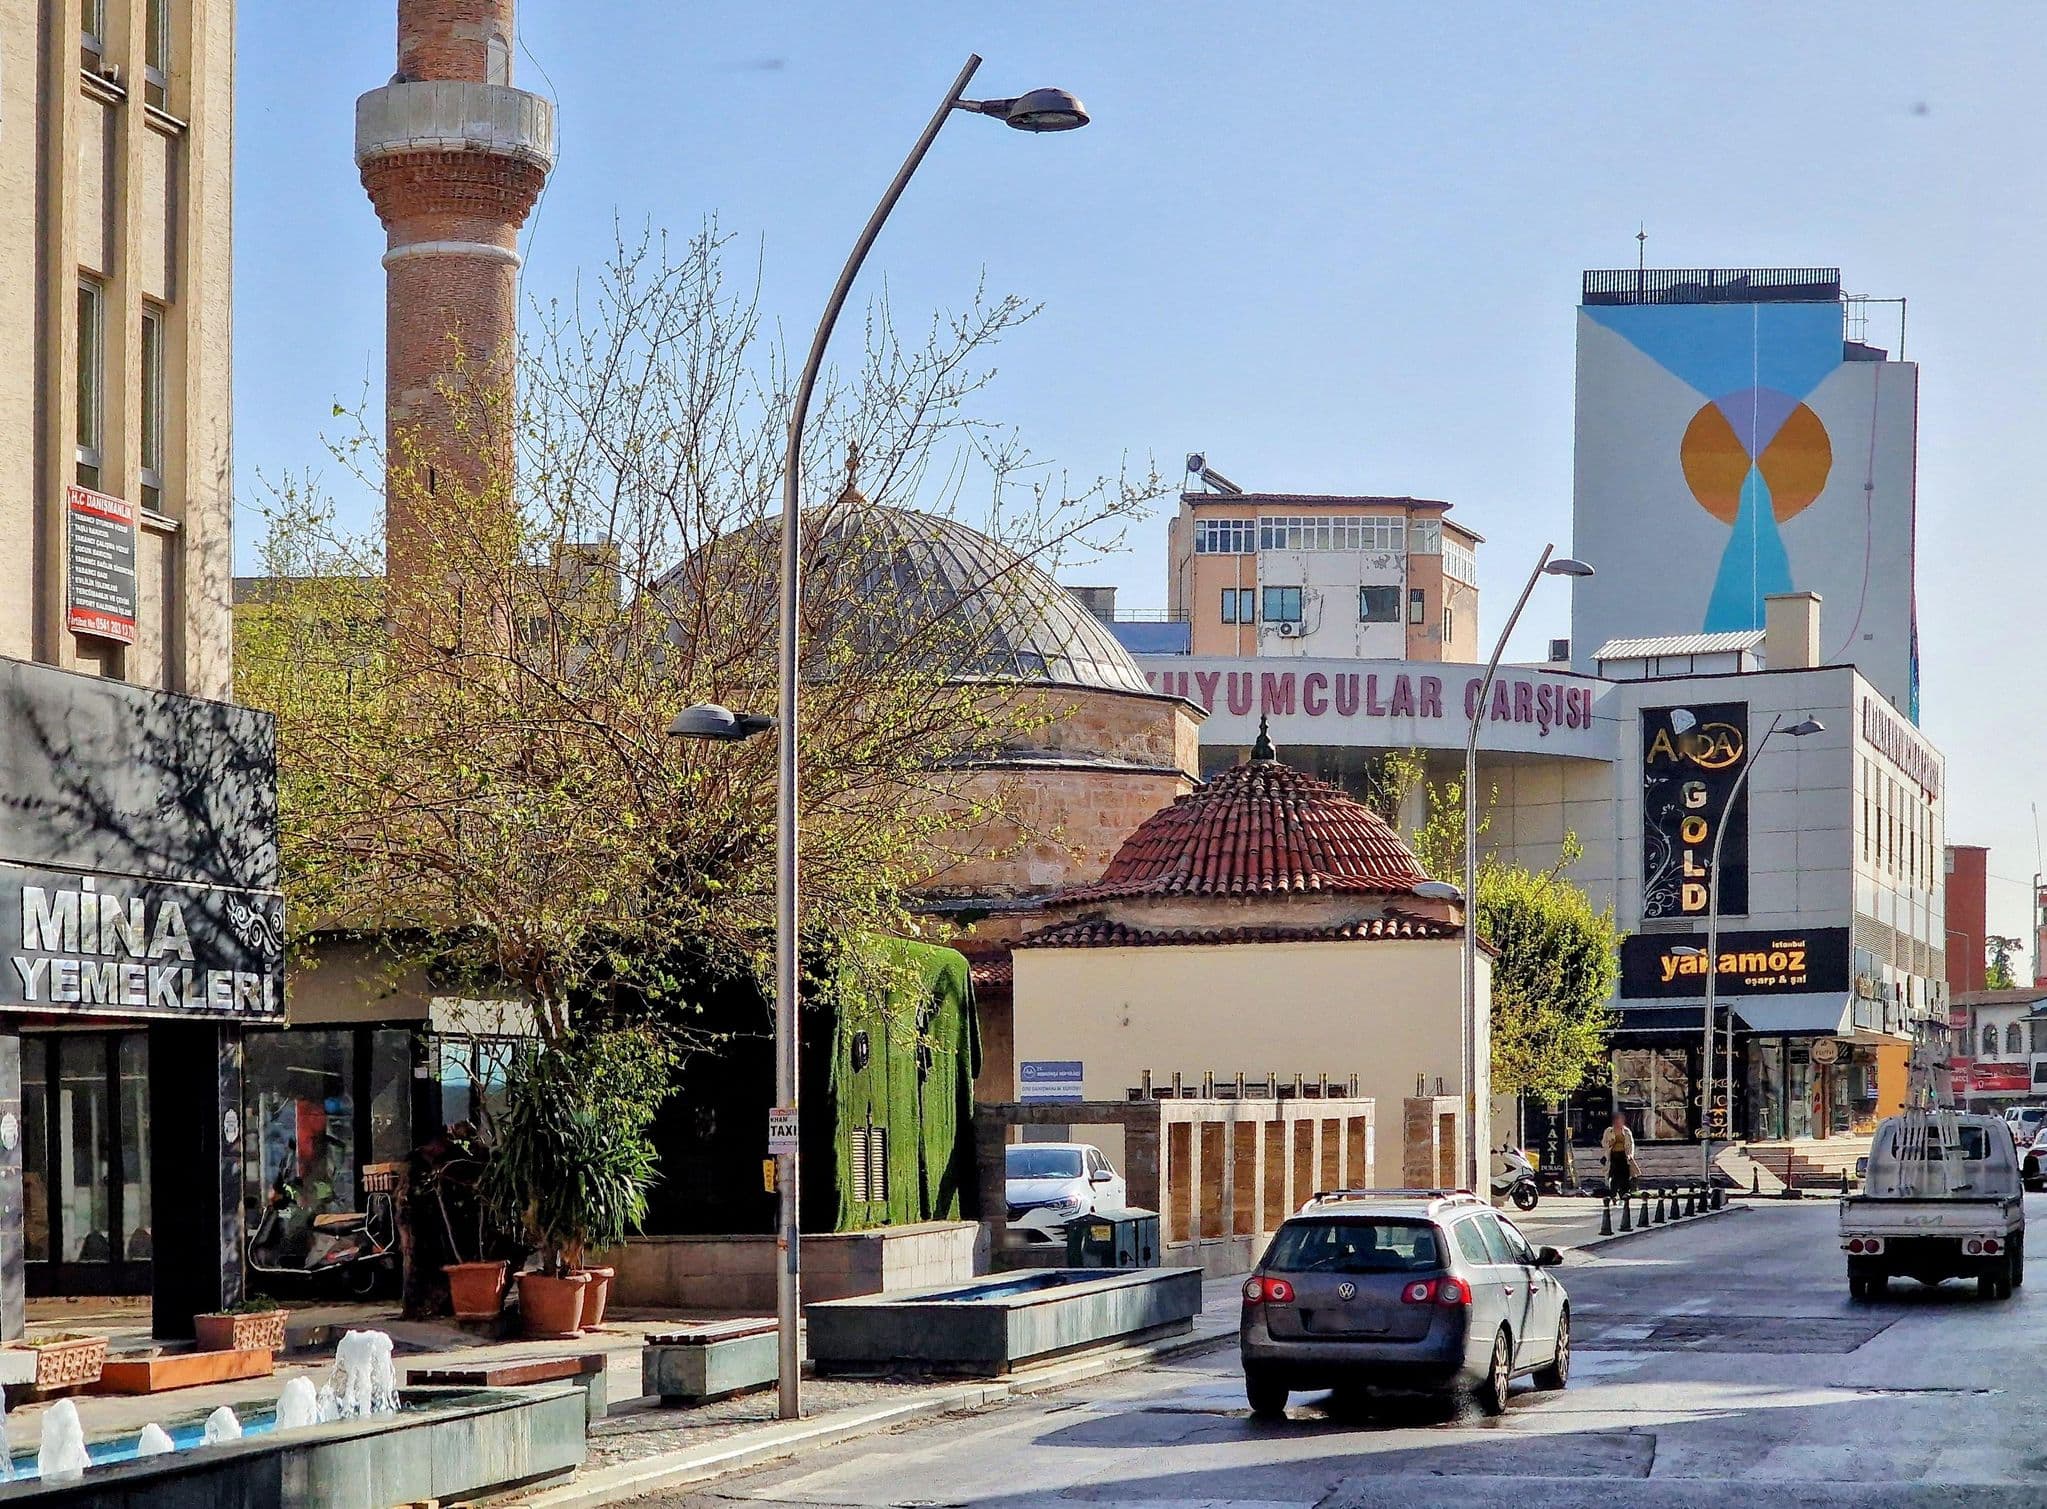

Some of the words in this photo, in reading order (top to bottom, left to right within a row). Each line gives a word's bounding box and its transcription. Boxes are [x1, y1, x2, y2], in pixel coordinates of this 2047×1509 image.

[1682, 781, 1708, 912] GOLD
[22, 876, 195, 961] MİNA
[12, 956, 275, 1012] YEMEKLERİ
[770, 1124, 797, 1137] TAXI
[1547, 1116, 1559, 1165] TAXİ
